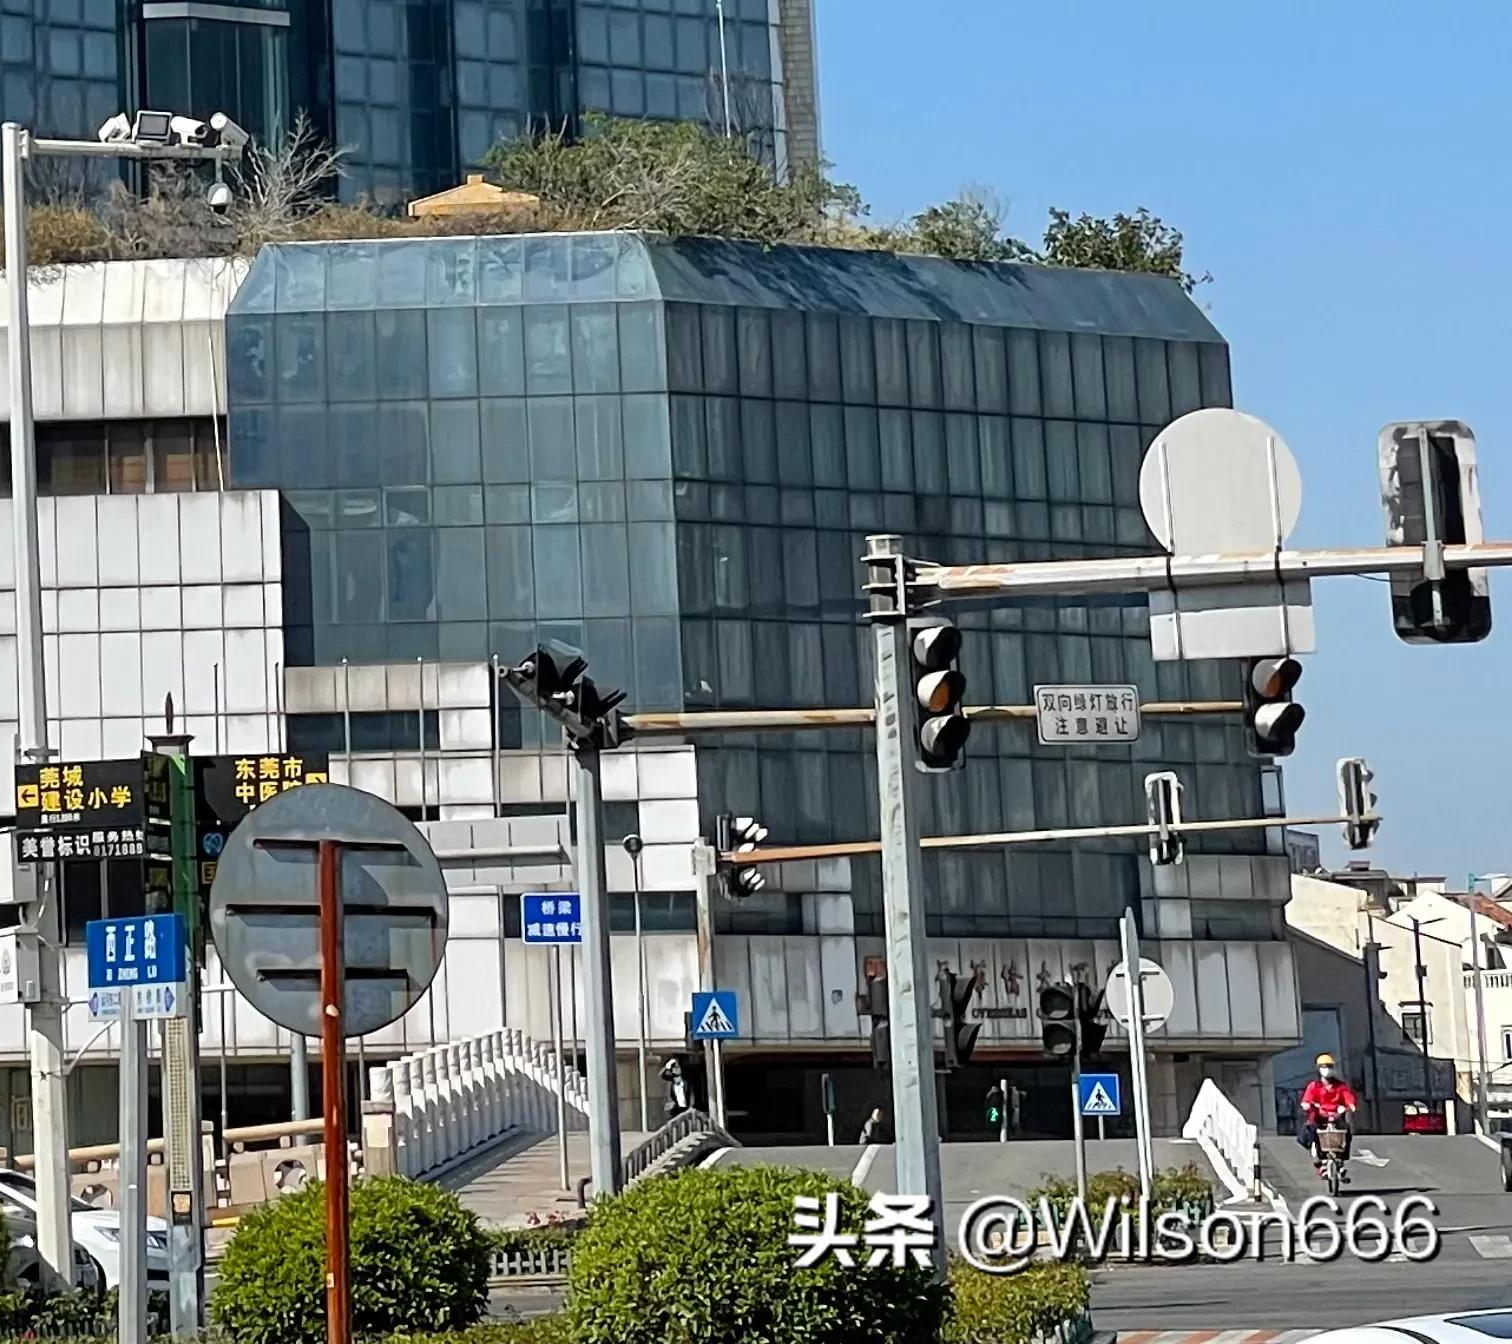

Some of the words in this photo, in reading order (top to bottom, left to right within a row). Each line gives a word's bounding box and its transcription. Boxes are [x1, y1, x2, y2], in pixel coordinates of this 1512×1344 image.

[1055, 716, 1129, 735] 注意避让
[39, 765, 84, 790] 莞城
[235, 757, 303, 780] 东莞市
[40, 785, 132, 812] 建设小学
